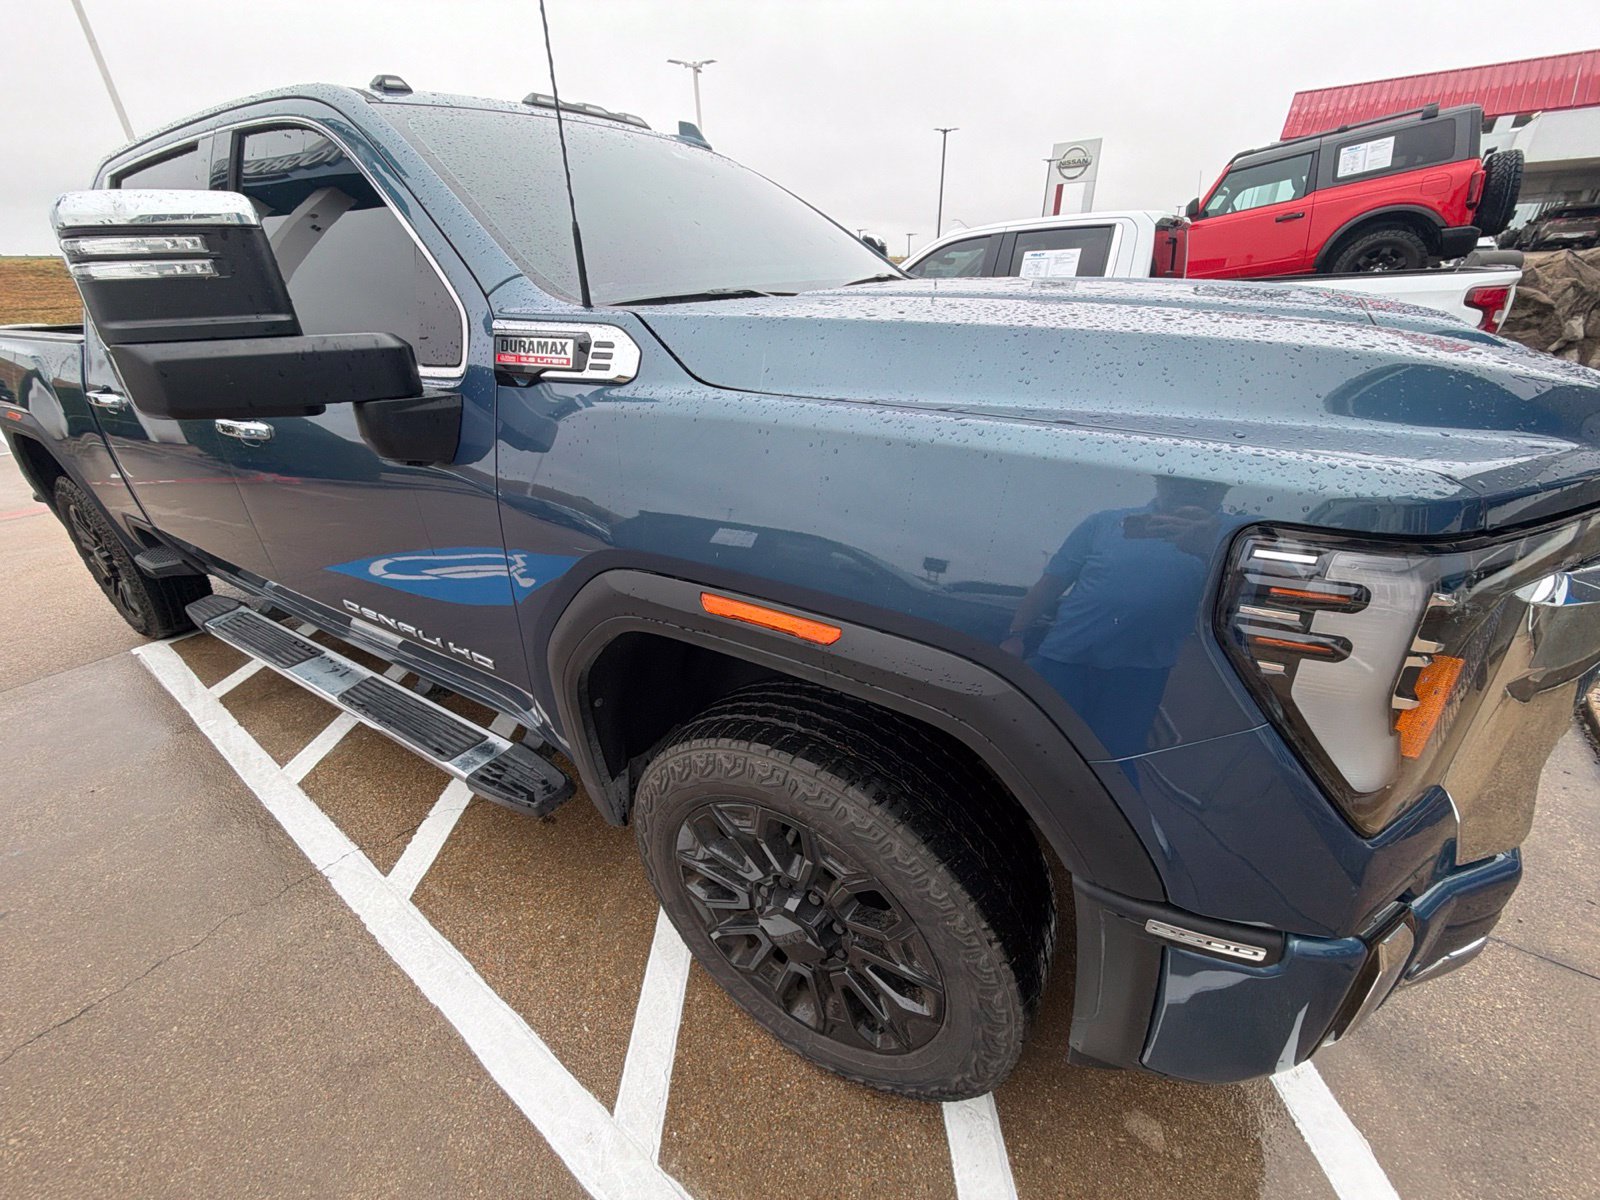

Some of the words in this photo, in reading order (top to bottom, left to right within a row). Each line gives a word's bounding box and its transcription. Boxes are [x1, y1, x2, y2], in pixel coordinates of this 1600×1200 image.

[1059, 157, 1089, 166] NISSAN
[500, 339, 568, 355] DURAMAX
[537, 357, 567, 365] LITER
[342, 599, 445, 648] DENALI
[448, 641, 496, 670] HD
